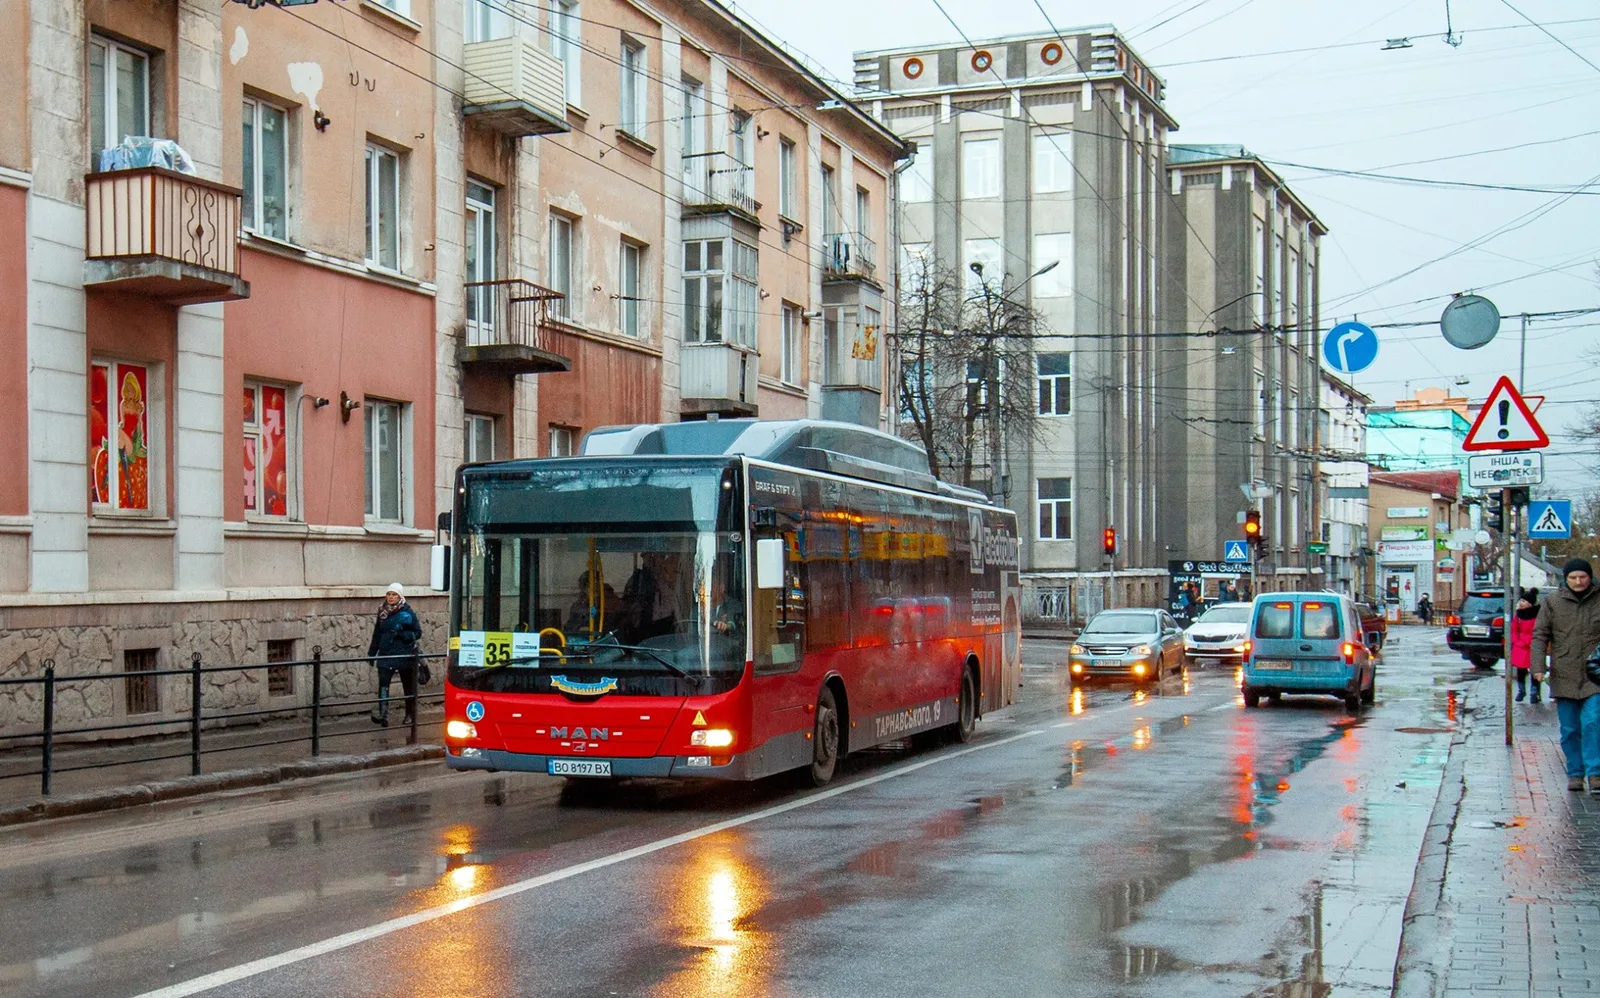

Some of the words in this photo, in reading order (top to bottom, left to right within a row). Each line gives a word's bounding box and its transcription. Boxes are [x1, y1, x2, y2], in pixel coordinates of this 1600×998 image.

[1491, 457, 1519, 466] ІНША
[776, 484, 790, 495] STIFT
[1197, 561, 1217, 572] Cat
[1218, 562, 1252, 573] Coffee
[1173, 575, 1189, 583] good
[486, 642, 511, 665] 35
[933, 699, 941, 722] 19
[550, 726, 609, 740] MAN
[554, 762, 569, 773] BO
[570, 763, 593, 774] 8197
[594, 764, 610, 775] BX
